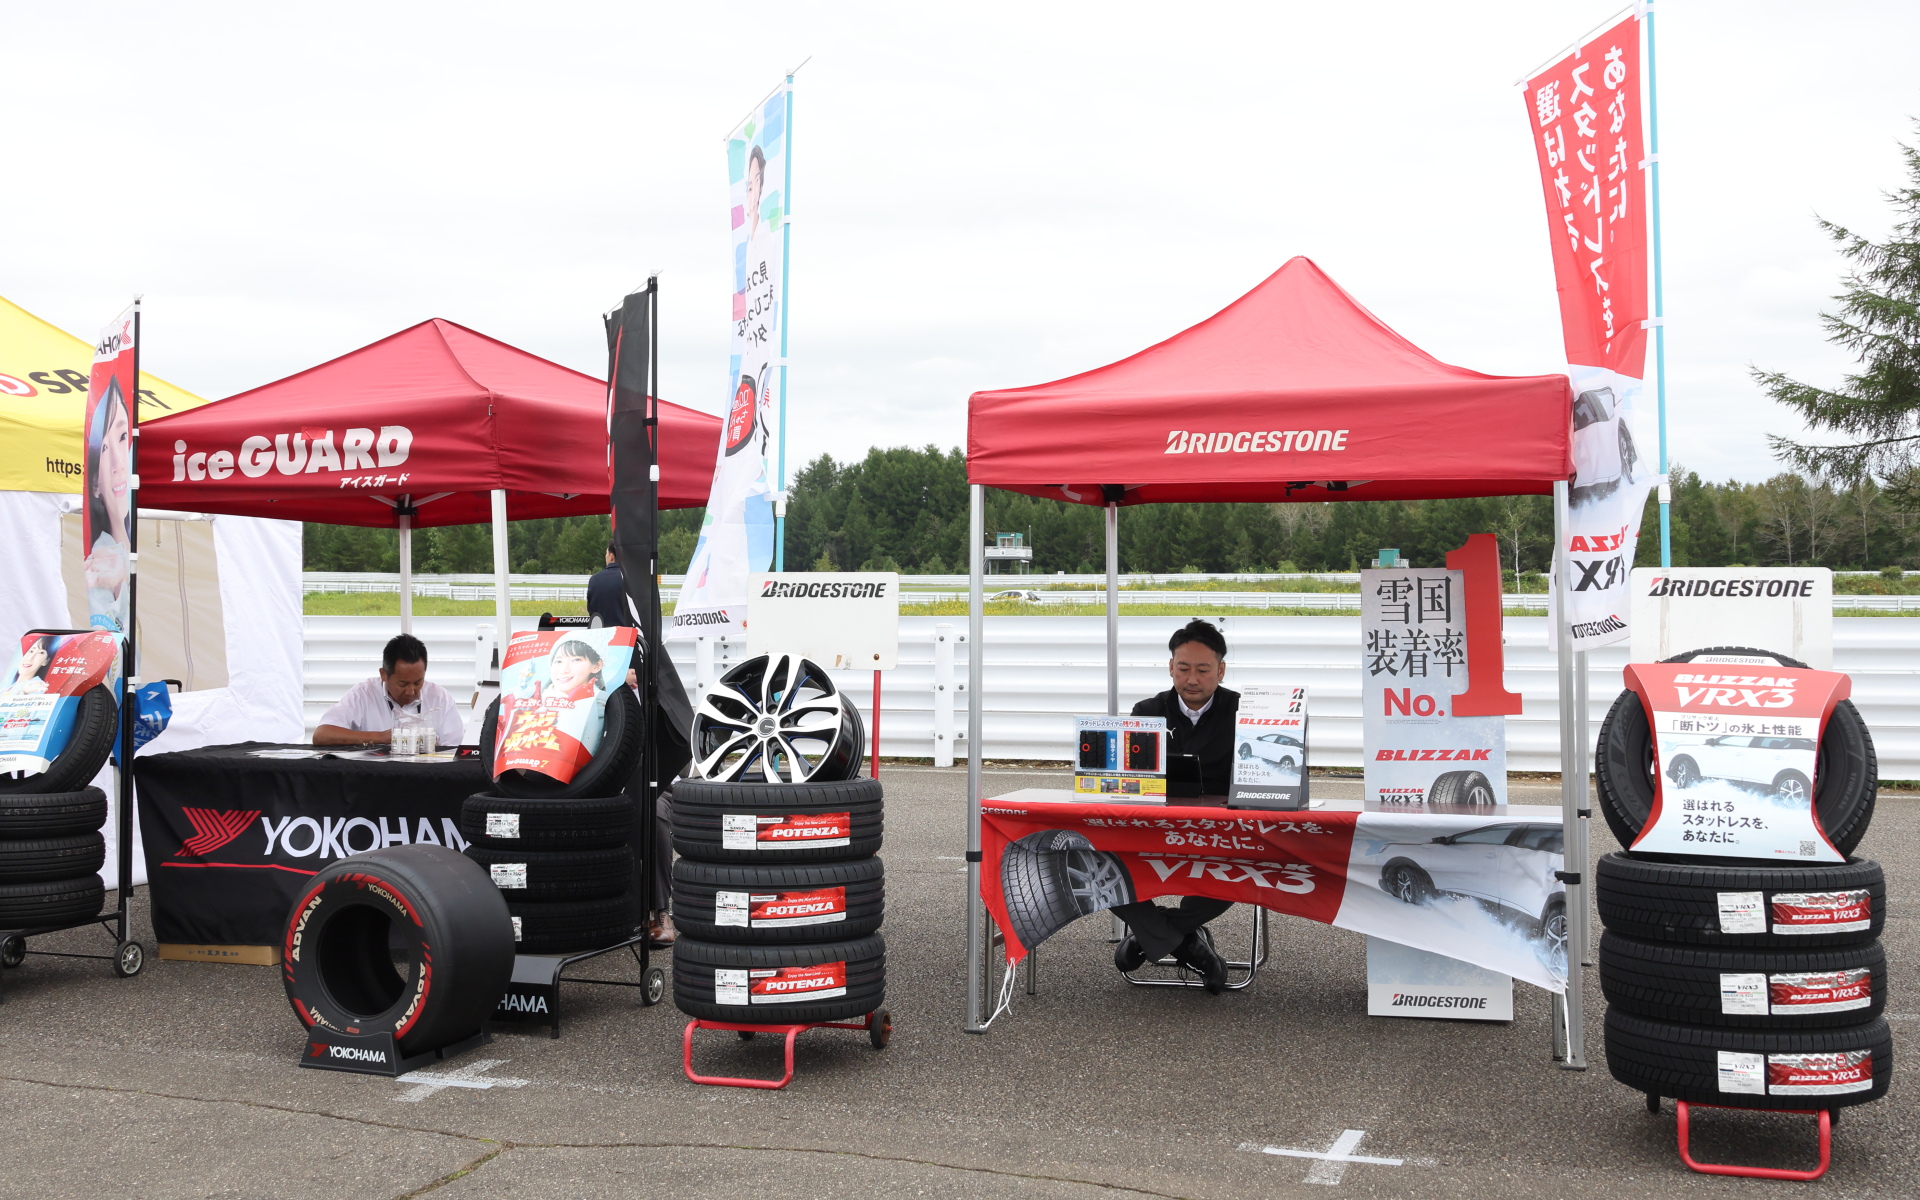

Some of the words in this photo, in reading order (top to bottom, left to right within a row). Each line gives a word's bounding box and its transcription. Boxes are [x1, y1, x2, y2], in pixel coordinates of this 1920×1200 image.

[1164, 430, 1350, 454] BRIDGESTONE
[339, 473, 411, 489] アイスガード
[761, 581, 887, 598] BRIDGESTONE
[1648, 577, 1815, 597] BRIDGESTONE
[1377, 576, 1452, 625] 雪国
[1384, 688, 1445, 717] No.
[1445, 533, 1523, 717] 1
[1367, 627, 1466, 678] 装着率
[1705, 656, 1767, 665] BRIDGESTONE
[1673, 674, 1799, 687] BLIZZAK
[1673, 686, 1797, 708] VRX3
[1239, 718, 1301, 726] BLIZZAK
[1672, 719, 1803, 736] 「断トツ」の氷上性能
[1375, 749, 1493, 761] BLIZZAK
[1236, 791, 1292, 800] BRIDGESTONE
[1682, 799, 1735, 813] 選ばれる
[1682, 814, 1769, 830] スタッドレスを、
[772, 826, 840, 837] POTENZA
[1682, 830, 1740, 845] あなたに。
[1165, 831, 1265, 851] あなたに。
[1142, 860, 1317, 895] VRX3
[367, 883, 408, 918] YOKOHAMA
[766, 902, 834, 916] POTENZA
[1833, 907, 1861, 920] VRX3
[292, 895, 323, 963] ADVAN
[766, 976, 834, 991] POTENZA
[394, 961, 426, 1031] ADVAN
[1832, 986, 1860, 999] VRX3
[1392, 993, 1488, 1009] BRIDGESTONE
[328, 1045, 387, 1064] YOKOHAMA
[1831, 1069, 1861, 1081] VRX3
